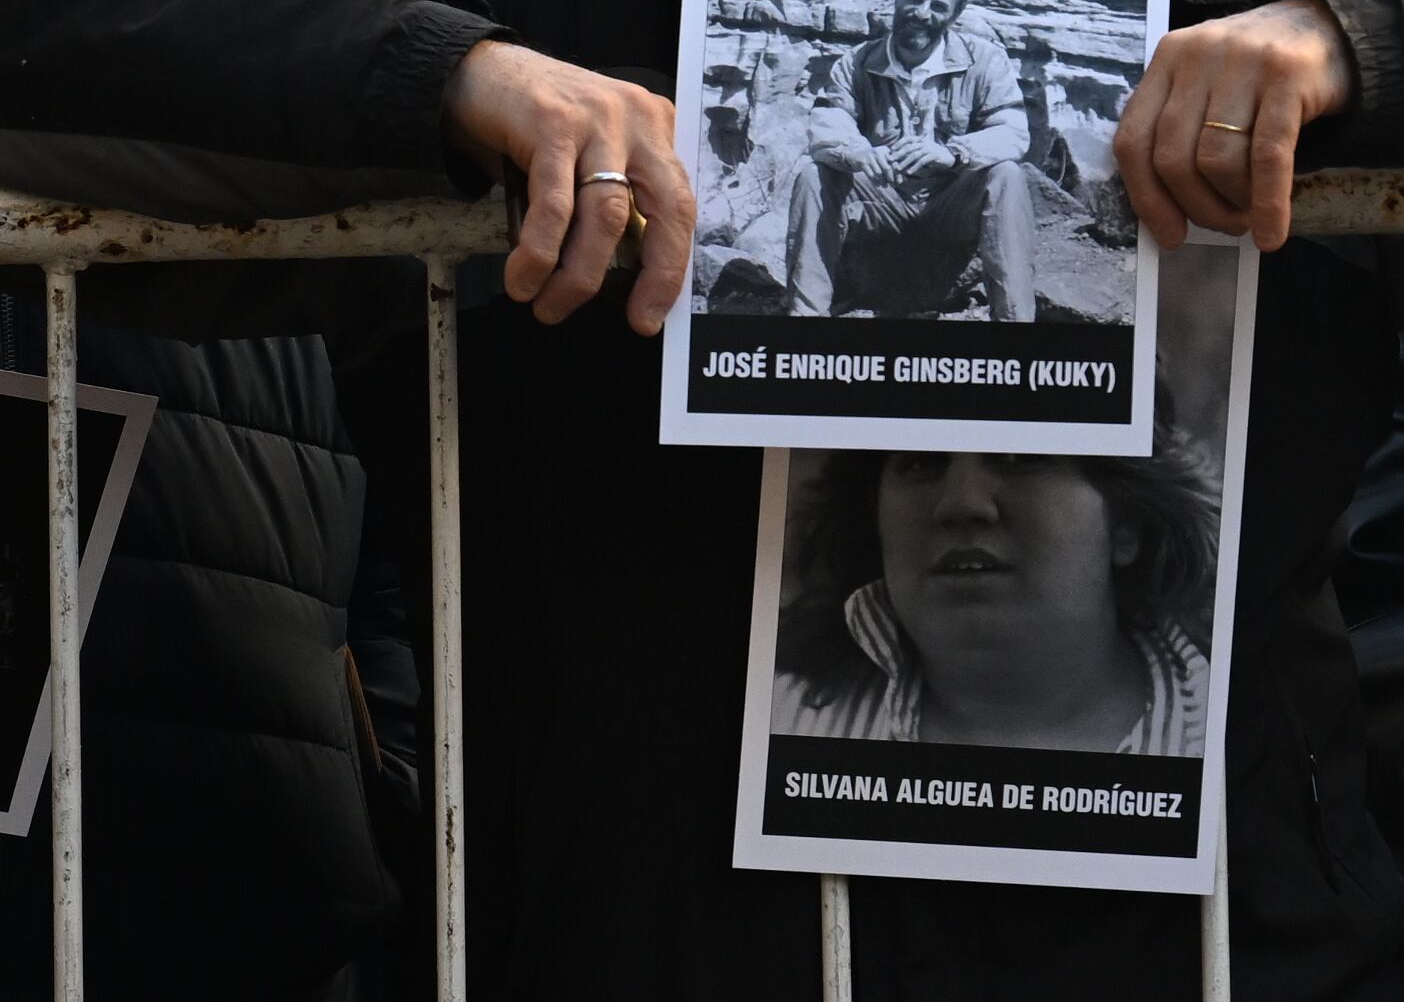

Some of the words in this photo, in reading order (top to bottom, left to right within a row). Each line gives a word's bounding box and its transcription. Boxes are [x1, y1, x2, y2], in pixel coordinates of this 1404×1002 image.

[702, 345, 767, 379] JOSÉ
[775, 353, 886, 384] ENRIQUE
[893, 356, 1021, 386] GINSBERG
[1028, 360, 1116, 394] (KUKY)
[784, 771, 889, 802] SILVANA
[895, 778, 994, 808] ALGUEA
[1002, 783, 1035, 810] DE
[1042, 783, 1183, 819] RODRÍGUEZ
